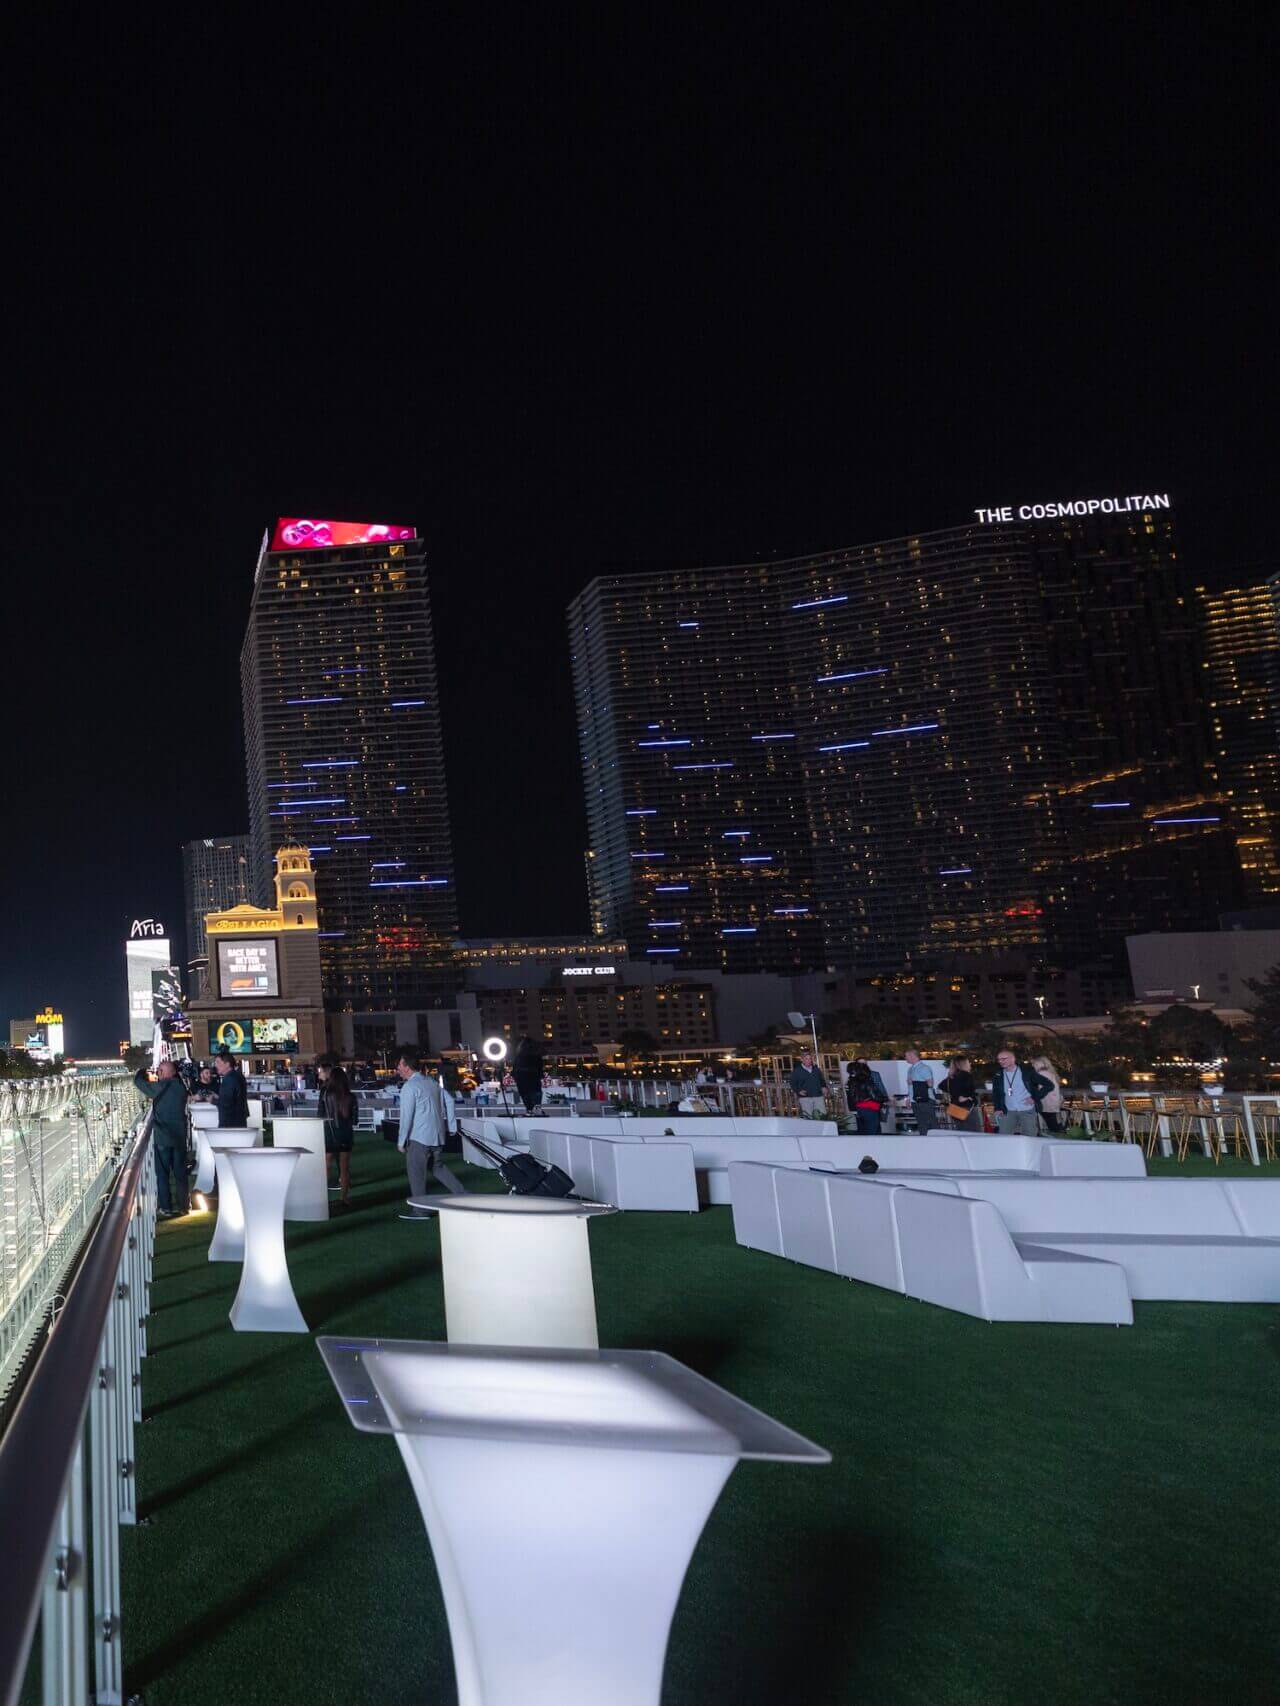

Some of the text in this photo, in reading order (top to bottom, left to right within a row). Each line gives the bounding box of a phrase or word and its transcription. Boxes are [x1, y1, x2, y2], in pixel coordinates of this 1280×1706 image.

[974, 493, 1171, 523] THE COSMOPOLITAN
[130, 919, 164, 938] Aria
[562, 966, 616, 975] JOCKEY CLUB
[35, 1014, 63, 1024] MGM
